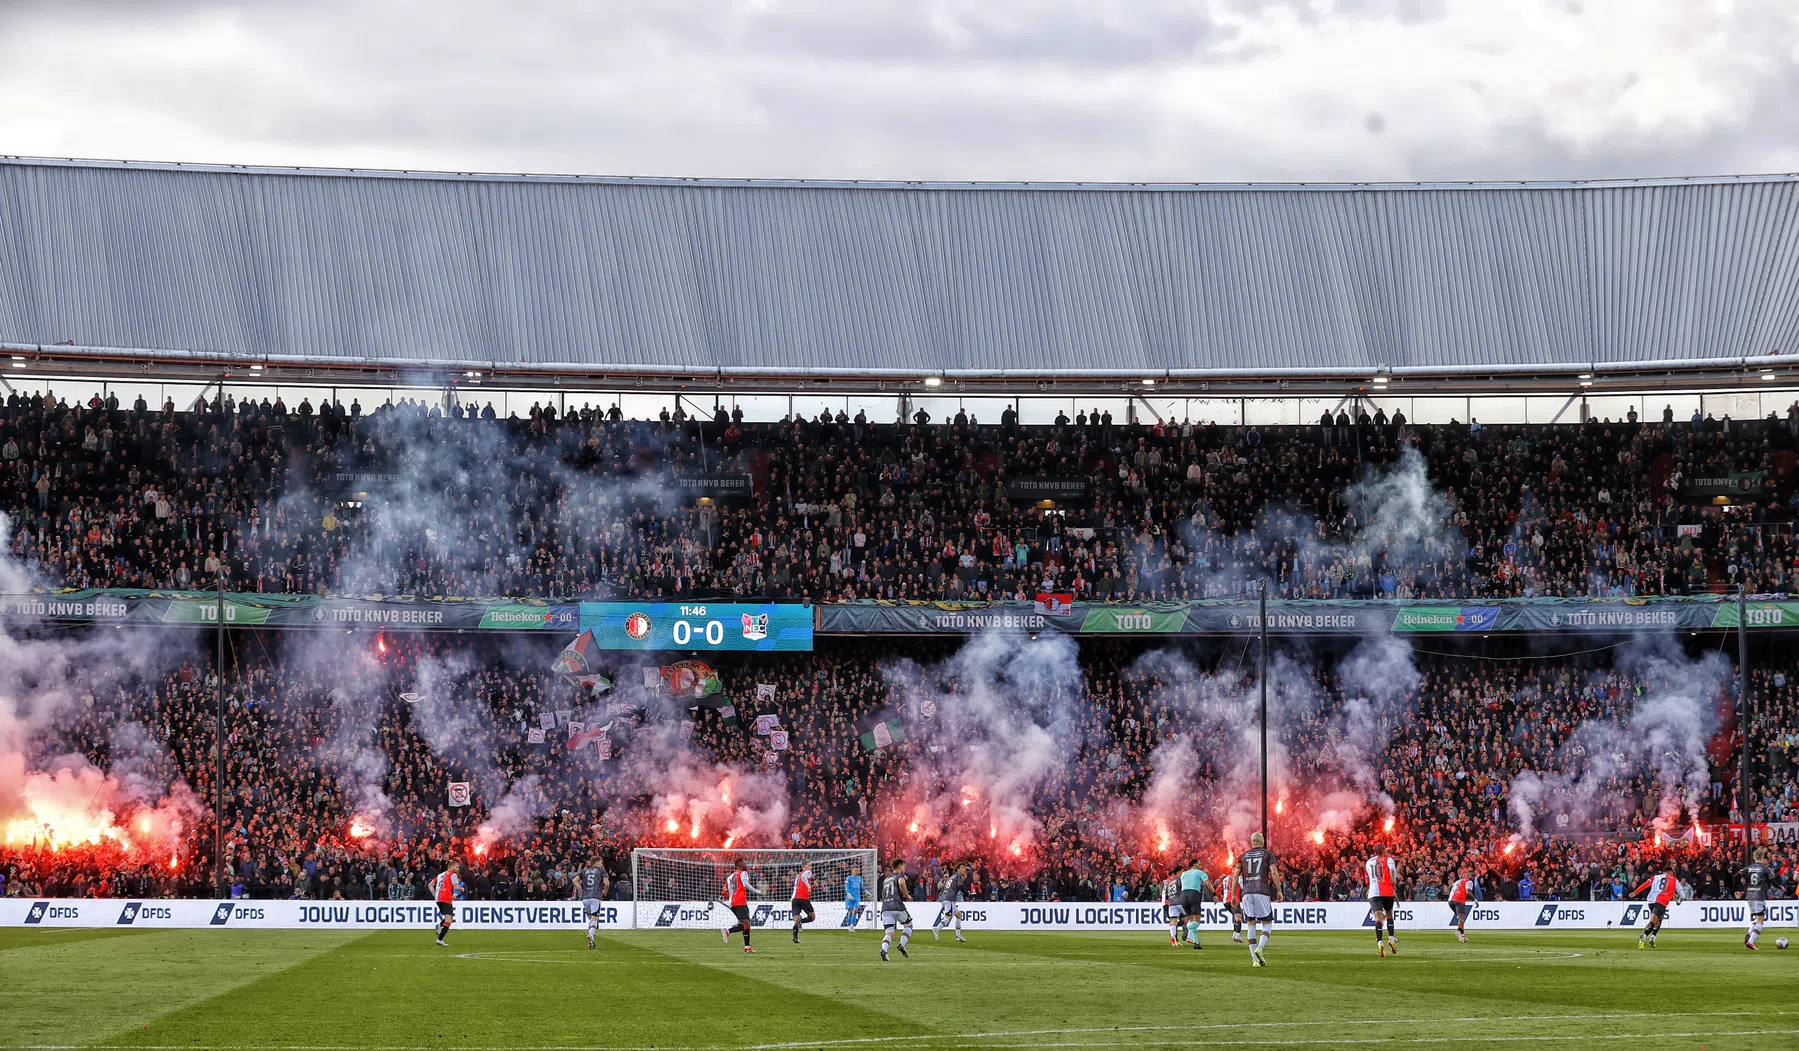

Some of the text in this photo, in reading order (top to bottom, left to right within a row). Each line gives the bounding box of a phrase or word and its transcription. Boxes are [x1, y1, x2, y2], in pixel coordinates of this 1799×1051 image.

[336, 473, 354, 481] TOTO
[1694, 478, 1728, 486] TOTO KNV
[680, 479, 745, 488] TOTO KNVB BEKER
[1020, 481, 1085, 490] TOTO KNVB BEKER
[16, 601, 127, 617] TOTO KNVB BEKER
[680, 605, 707, 616] 11:46
[332, 608, 443, 624] TOTO KNVB BEKER
[491, 611, 541, 622] Heineken
[935, 614, 1045, 628] TOTO KNVB BEKER
[1246, 615, 1356, 628] TOO KNVB BEKER
[1403, 614, 1453, 625] Heineken
[1567, 611, 1676, 625] TOTO KNVB BEKER
[1748, 609, 1783, 624] TOTO
[1116, 615, 1152, 630] TOTO
[745, 624, 765, 635] NEC
[1245, 857, 1263, 874] 17
[1370, 862, 1383, 878] 10
[587, 874, 595, 886] 5
[1659, 877, 1668, 891] 8
[49, 907, 79, 918] DFDS
[142, 907, 171, 919] DFDS
[235, 908, 265, 920] DFDS
[299, 906, 350, 923] JOUW
[681, 910, 709, 921] DFDS
[1020, 908, 1070, 924] JOUW
[1394, 910, 1414, 921] FDS
[1473, 910, 1500, 921] DFDS
[1558, 909, 1585, 920] DFDS
[1700, 906, 1745, 922] JOUW
